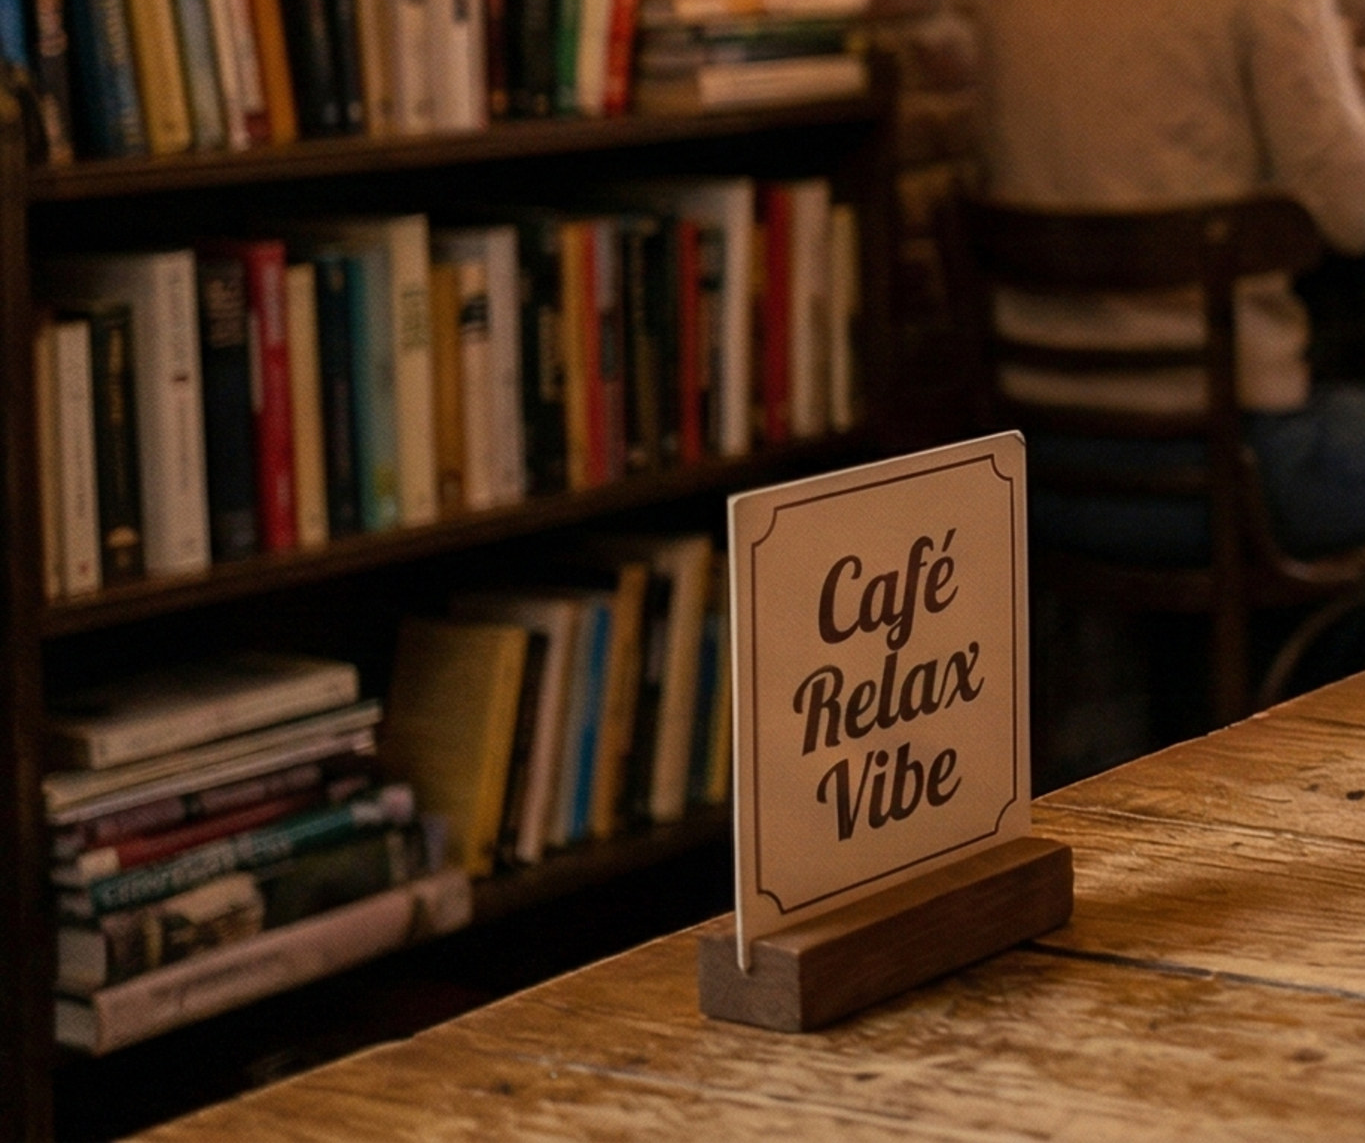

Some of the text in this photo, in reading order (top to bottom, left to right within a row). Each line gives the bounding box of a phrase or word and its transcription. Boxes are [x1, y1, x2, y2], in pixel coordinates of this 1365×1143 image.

[817, 527, 959, 651] Café
[792, 641, 985, 756] Relax
[816, 742, 962, 842] Vibe
